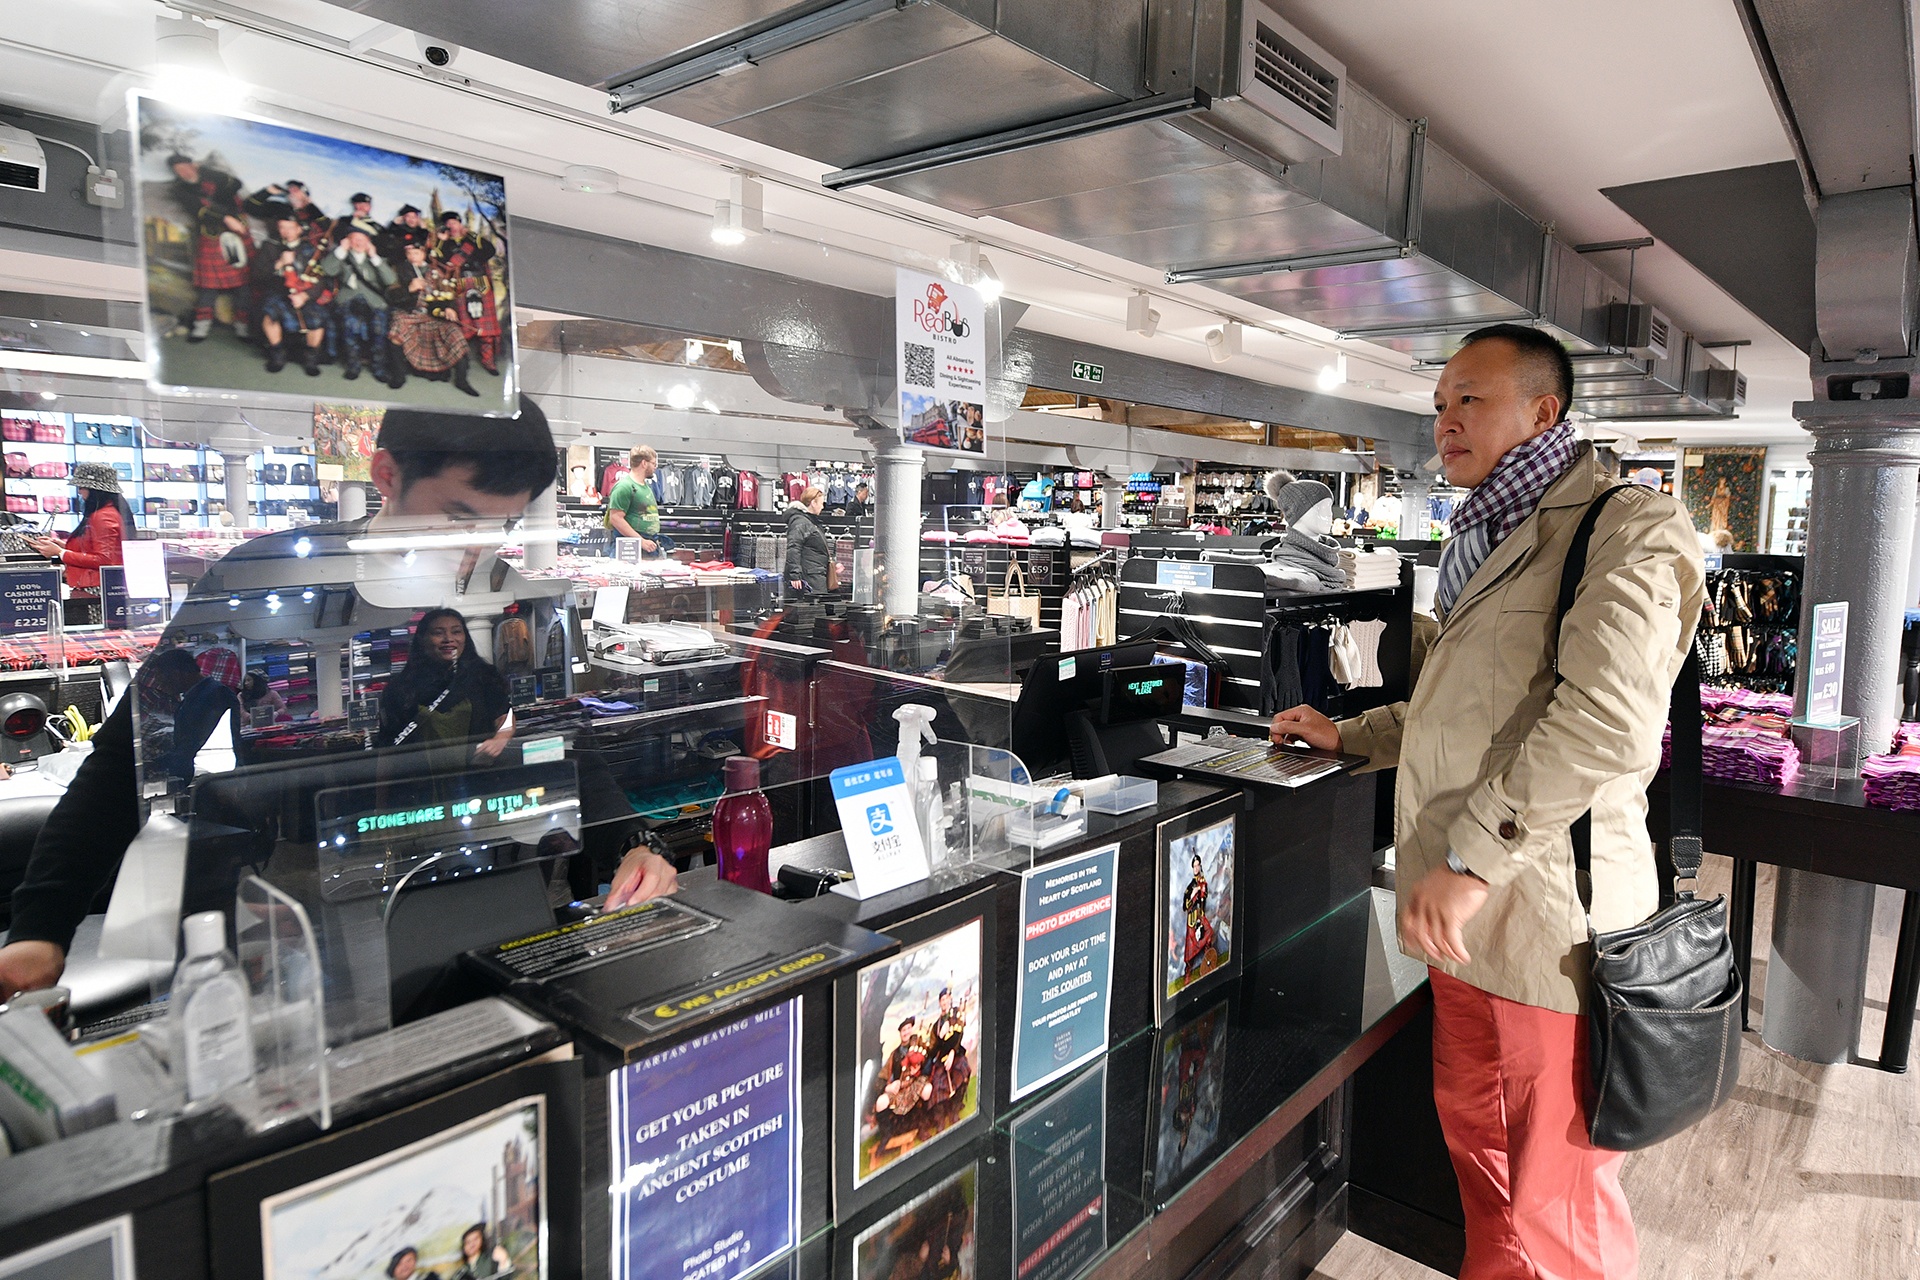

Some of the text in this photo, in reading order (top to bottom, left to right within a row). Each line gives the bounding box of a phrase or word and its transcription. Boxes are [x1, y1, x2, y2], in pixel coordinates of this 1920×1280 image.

[933, 334, 957, 344] BISTRO
[964, 565, 984, 574] £179
[1031, 565, 1049, 574] £59
[4, 590, 52, 598] CASHMERE
[14, 617, 47, 627] £225
[1821, 618, 1841, 635] SALE
[1128, 680, 1163, 690] NEXT CUSTOMER
[1135, 687, 1152, 695] PLEASE
[1822, 681, 1838, 699] £30
[357, 805, 445, 833] STONEWARE
[487, 794, 523, 812] WITH
[873, 834, 902, 855] 支付宝
[1039, 878, 1102, 907] HEART OF SCOTLAND
[1045, 872, 1079, 890] MEMORIES
[1086, 865, 1098, 877] THE
[1026, 897, 1111, 938] PHOTO EXPERIENCE
[1028, 931, 1106, 973] BOOK YOUR SLOT TIME
[679, 994, 714, 1011] WE
[714, 968, 780, 999] ACCEPT
[780, 952, 826, 974] EURO
[1048, 956, 1088, 982] AND PAY AT
[1042, 971, 1093, 1002] THIS COUNTER
[1032, 1015, 1046, 1028] YOUR
[1047, 1005, 1067, 1021] PHOTOS
[1077, 991, 1098, 1006] PRINTED
[635, 1005, 783, 1073] TARTAN WEAVING MILL
[636, 1062, 784, 1144] GET YOUR PICTURE
[676, 1104, 751, 1152] TAKEN IN
[637, 1114, 783, 1201] ANCIENT SCOTTISH
[675, 1153, 751, 1203] COSTUME
[682, 1254, 727, 1280] CATED
[727, 1245, 739, 1263] IN
[683, 1229, 744, 1272] Photo Studio
